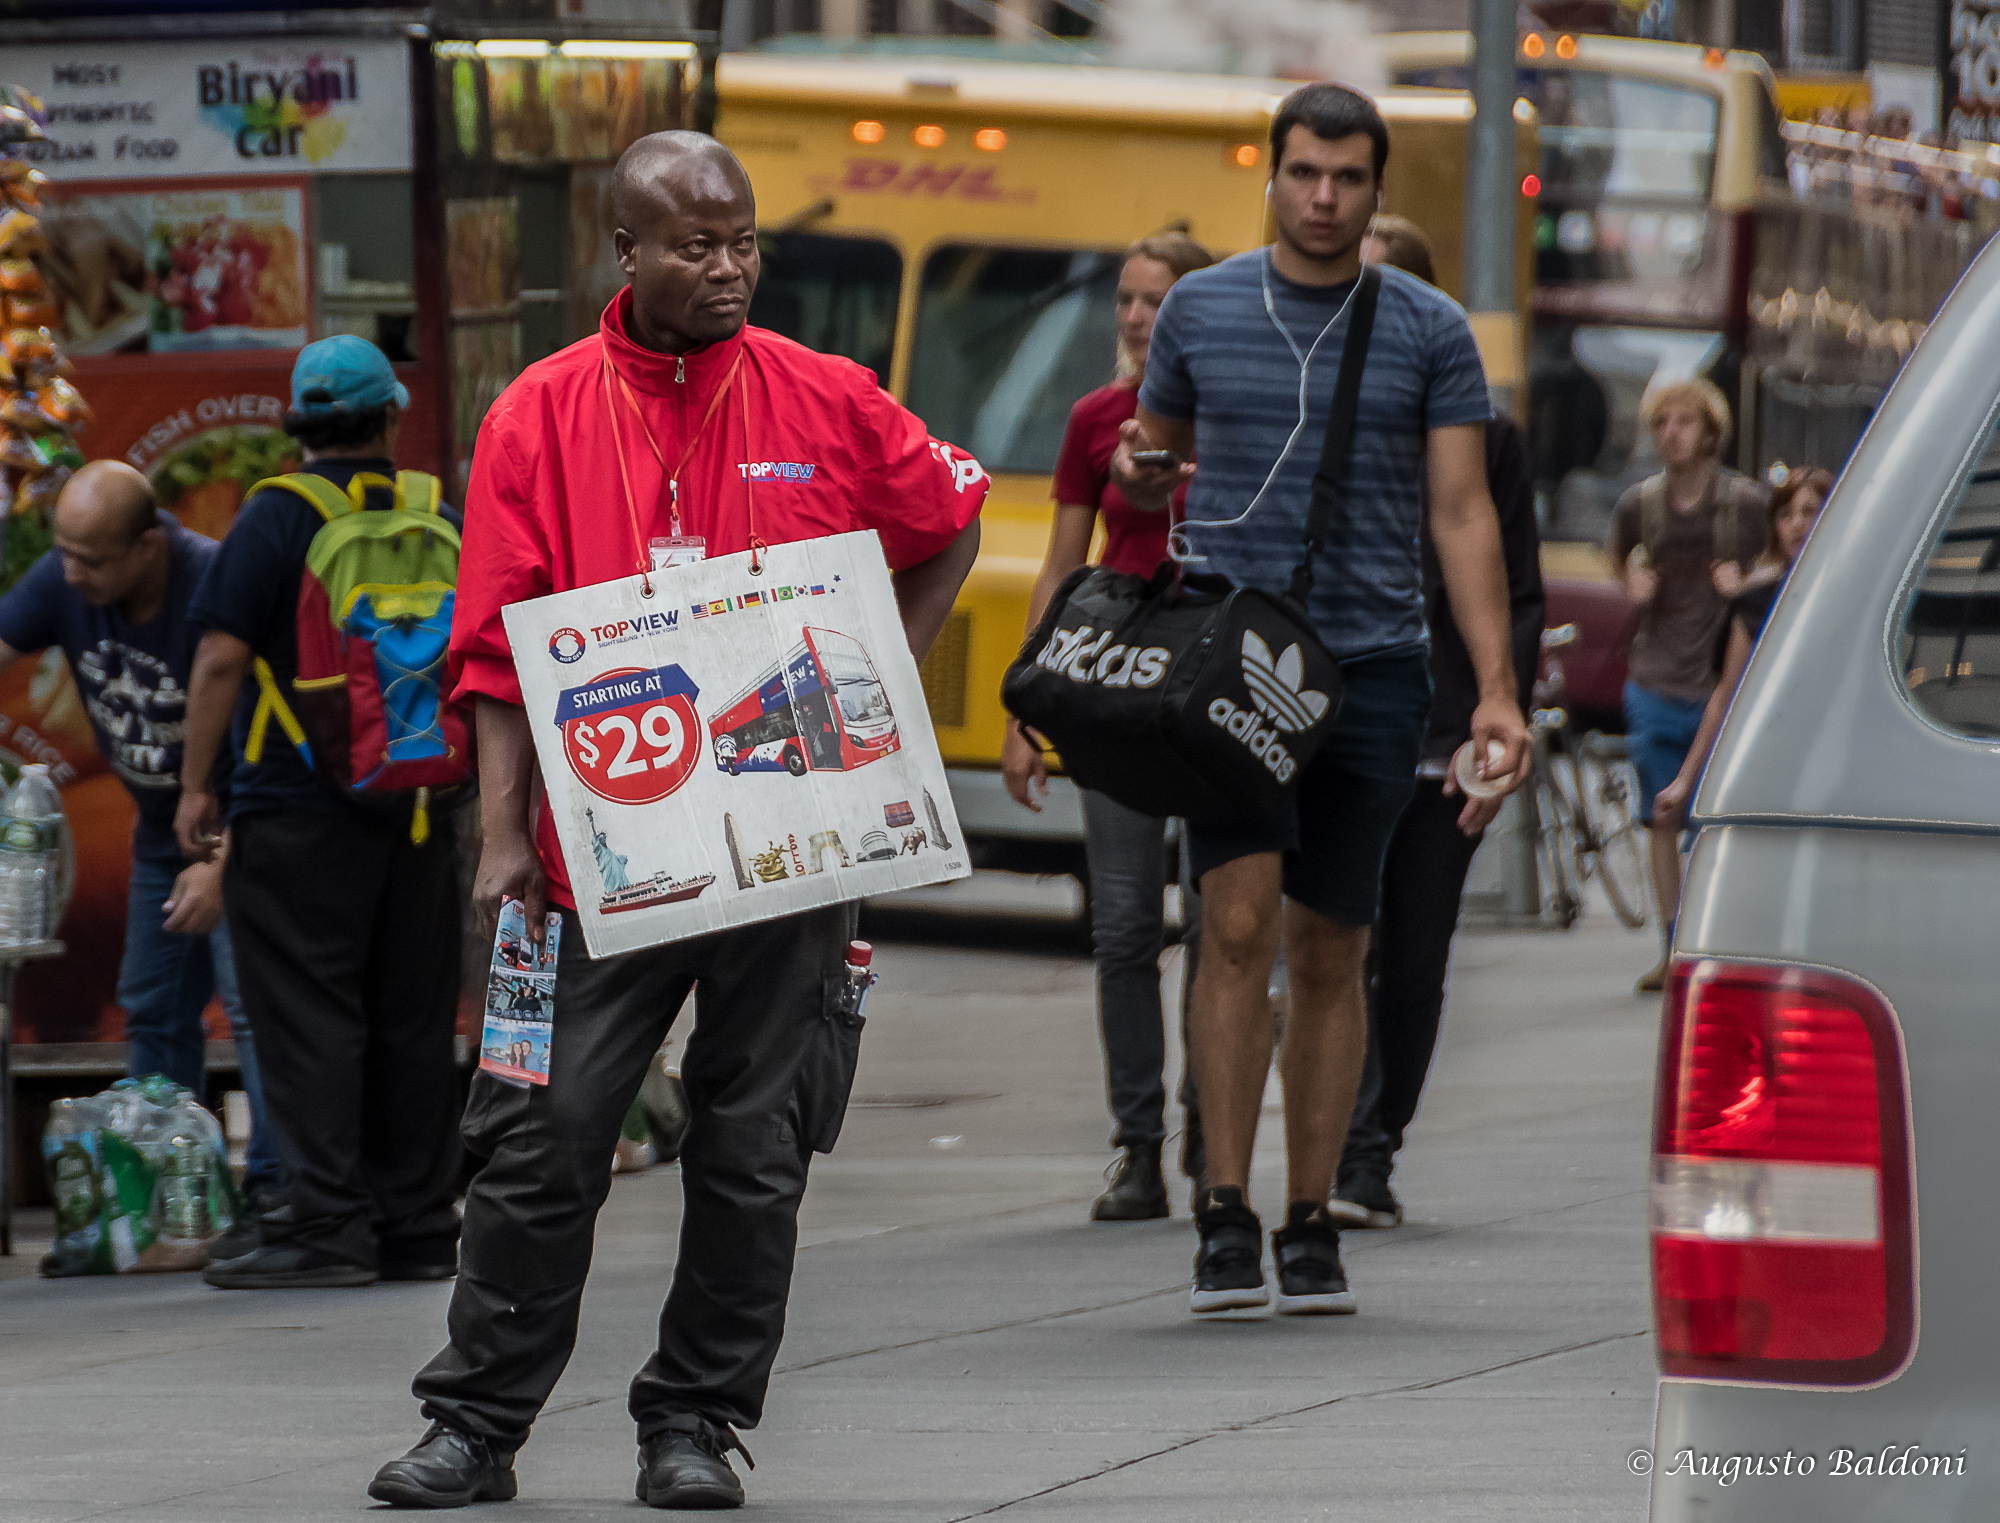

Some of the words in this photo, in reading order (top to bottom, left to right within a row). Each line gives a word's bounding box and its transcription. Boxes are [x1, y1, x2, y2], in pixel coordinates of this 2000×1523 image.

[199, 56, 357, 116] Biryani
[842, 157, 1004, 202] DHL
[127, 408, 194, 466] FISH
[196, 393, 284, 422] OVER
[737, 461, 816, 479] TOPVIEW
[590, 609, 680, 642] TOPVIEW
[597, 634, 639, 649] SIGHTSEEING
[646, 629, 661, 637] NEW
[662, 626, 679, 634] YORK
[573, 680, 641, 708] STARTING
[645, 675, 662, 692] AT
[574, 705, 685, 780] $29
[1208, 697, 1298, 785] adidas
